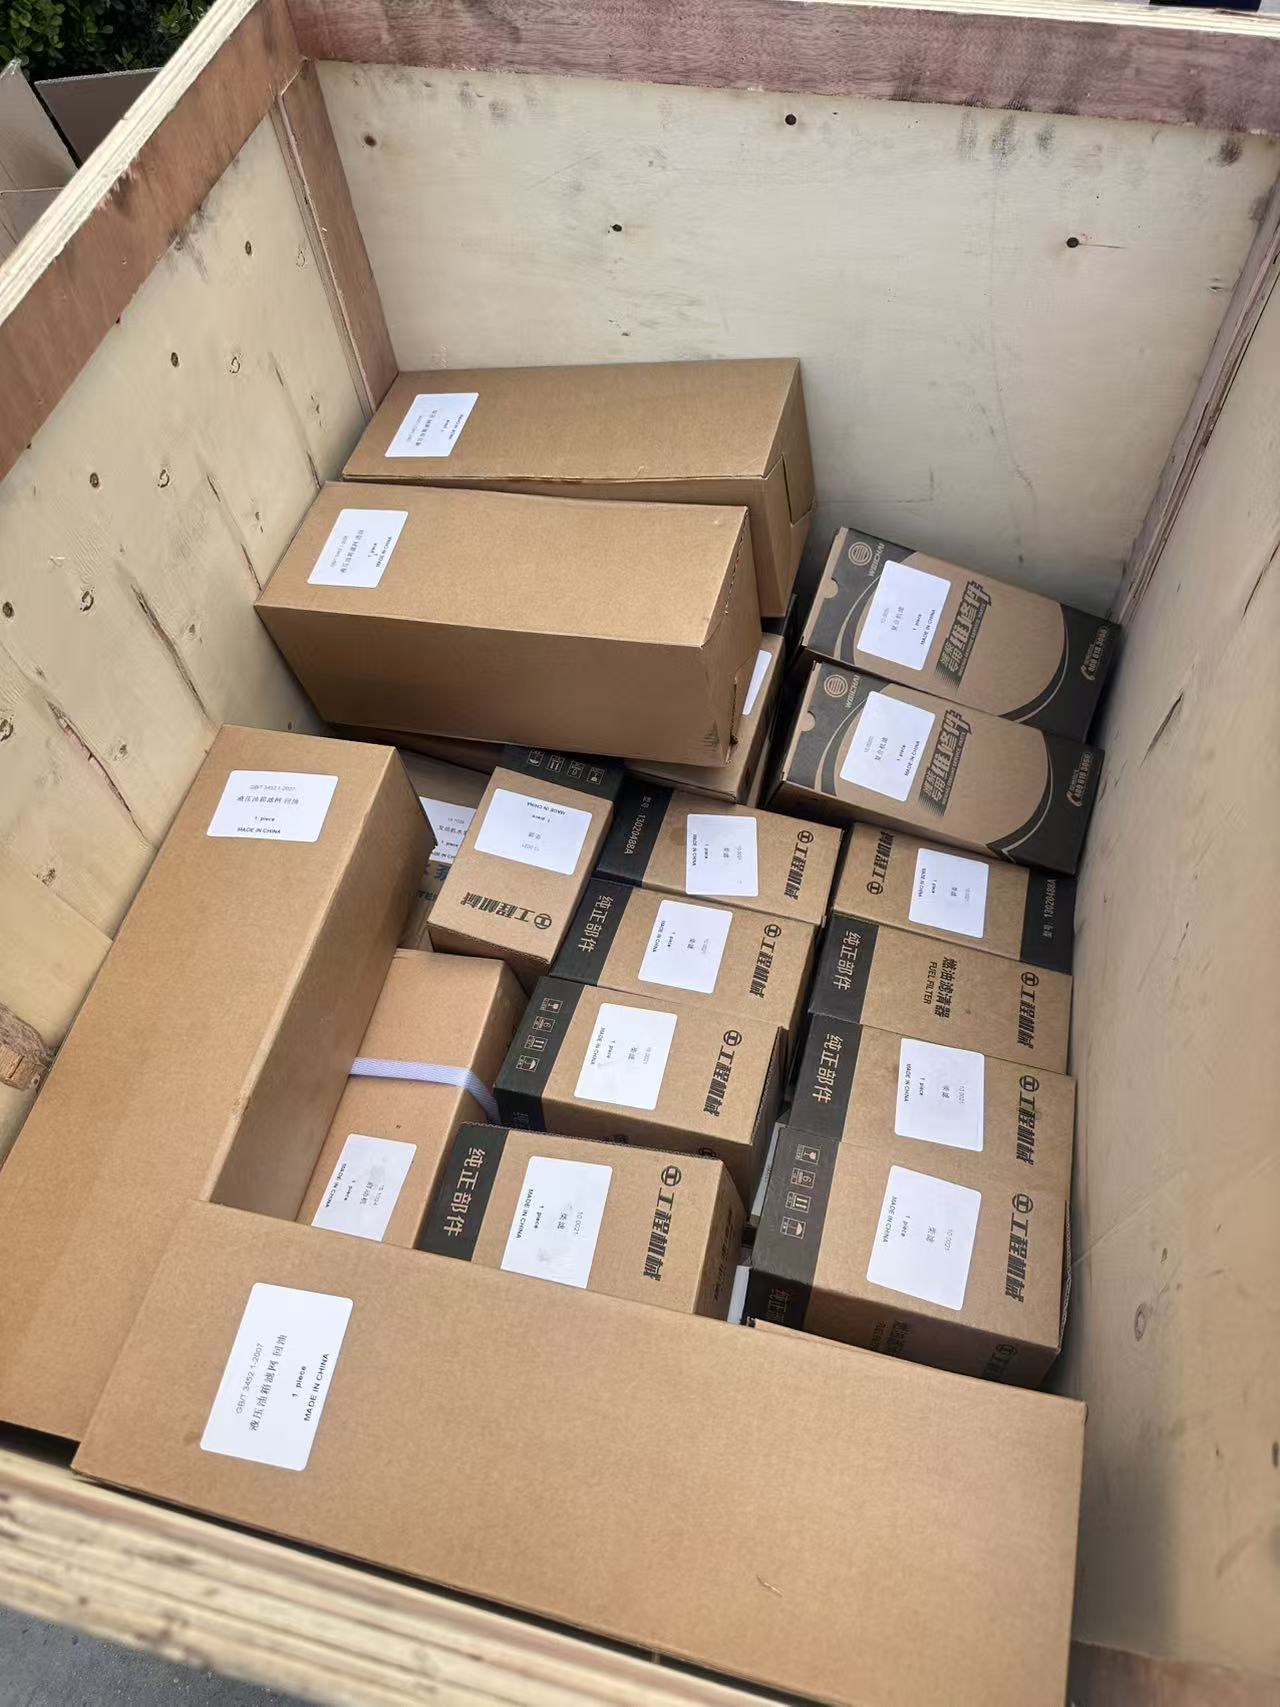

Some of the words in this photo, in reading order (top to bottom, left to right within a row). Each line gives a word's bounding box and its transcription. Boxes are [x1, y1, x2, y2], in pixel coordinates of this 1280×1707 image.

[868, 543, 884, 577] WEICHAI
[845, 675, 860, 708] WEICHAI
[904, 761, 913, 776] MADE
[911, 740, 920, 756] CHINA
[526, 801, 543, 809] CHINA
[550, 807, 566, 815] MADE
[624, 814, 646, 855] 13020488A
[783, 843, 809, 900] 工程机械
[871, 831, 895, 883] 工程机械
[460, 892, 535, 923] 工程机械
[578, 895, 614, 953] 纯正部件
[658, 920, 666, 933] MADE
[652, 939, 660, 952] CHINA
[833, 930, 861, 991] 纯正部件
[749, 937, 776, 998] 工程机械
[928, 961, 938, 979] FUEL
[923, 980, 935, 1005] FILTER
[934, 957, 958, 1018] 燃油滤清器
[597, 1027, 606, 1042] MADE
[1017, 987, 1036, 1048] 工程机械
[590, 1049, 599, 1065] CHINA
[812, 1033, 844, 1104] 纯正部件
[703, 1046, 735, 1117] 工程机械
[1016, 1092, 1036, 1165] 工程机械
[336, 1163, 347, 1181] MADE
[324, 1189, 336, 1208] CHINA
[443, 1147, 486, 1237] 纯正部件
[524, 1188, 534, 1208] MADE
[888, 1196, 898, 1215] MADE
[515, 1217, 527, 1239] CHINA
[643, 1187, 675, 1282] 工程机械
[882, 1222, 892, 1243] CHINA
[1004, 1212, 1030, 1302] 工程机械
[248, 1360, 279, 1431] 液压油箱滤网
[272, 1333, 288, 1356] 回油
[303, 1394, 317, 1422] MADE
[316, 1352, 330, 1381] CHINA
[236, 1393, 248, 1414] GB/T
